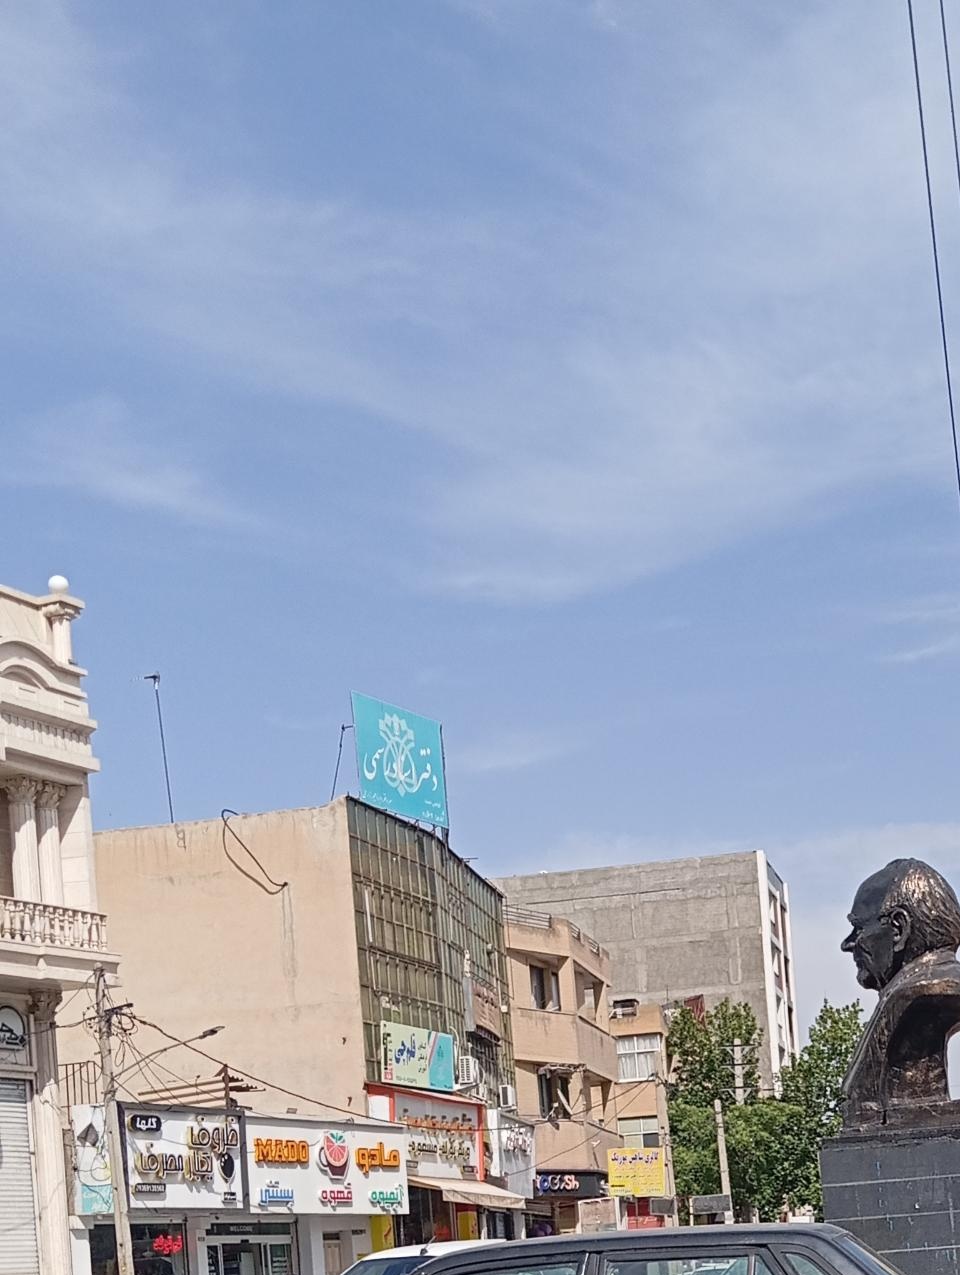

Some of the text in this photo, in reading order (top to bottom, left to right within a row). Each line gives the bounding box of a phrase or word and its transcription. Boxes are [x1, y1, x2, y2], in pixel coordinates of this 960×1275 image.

[187, 1116, 240, 1154] ظروف
[136, 1142, 184, 1179] مصرف
[254, 1138, 309, 1164] MADO
[356, 1142, 401, 1174] مادو
[257, 1180, 295, 1208] بستنی
[320, 1182, 353, 1207] قهوه
